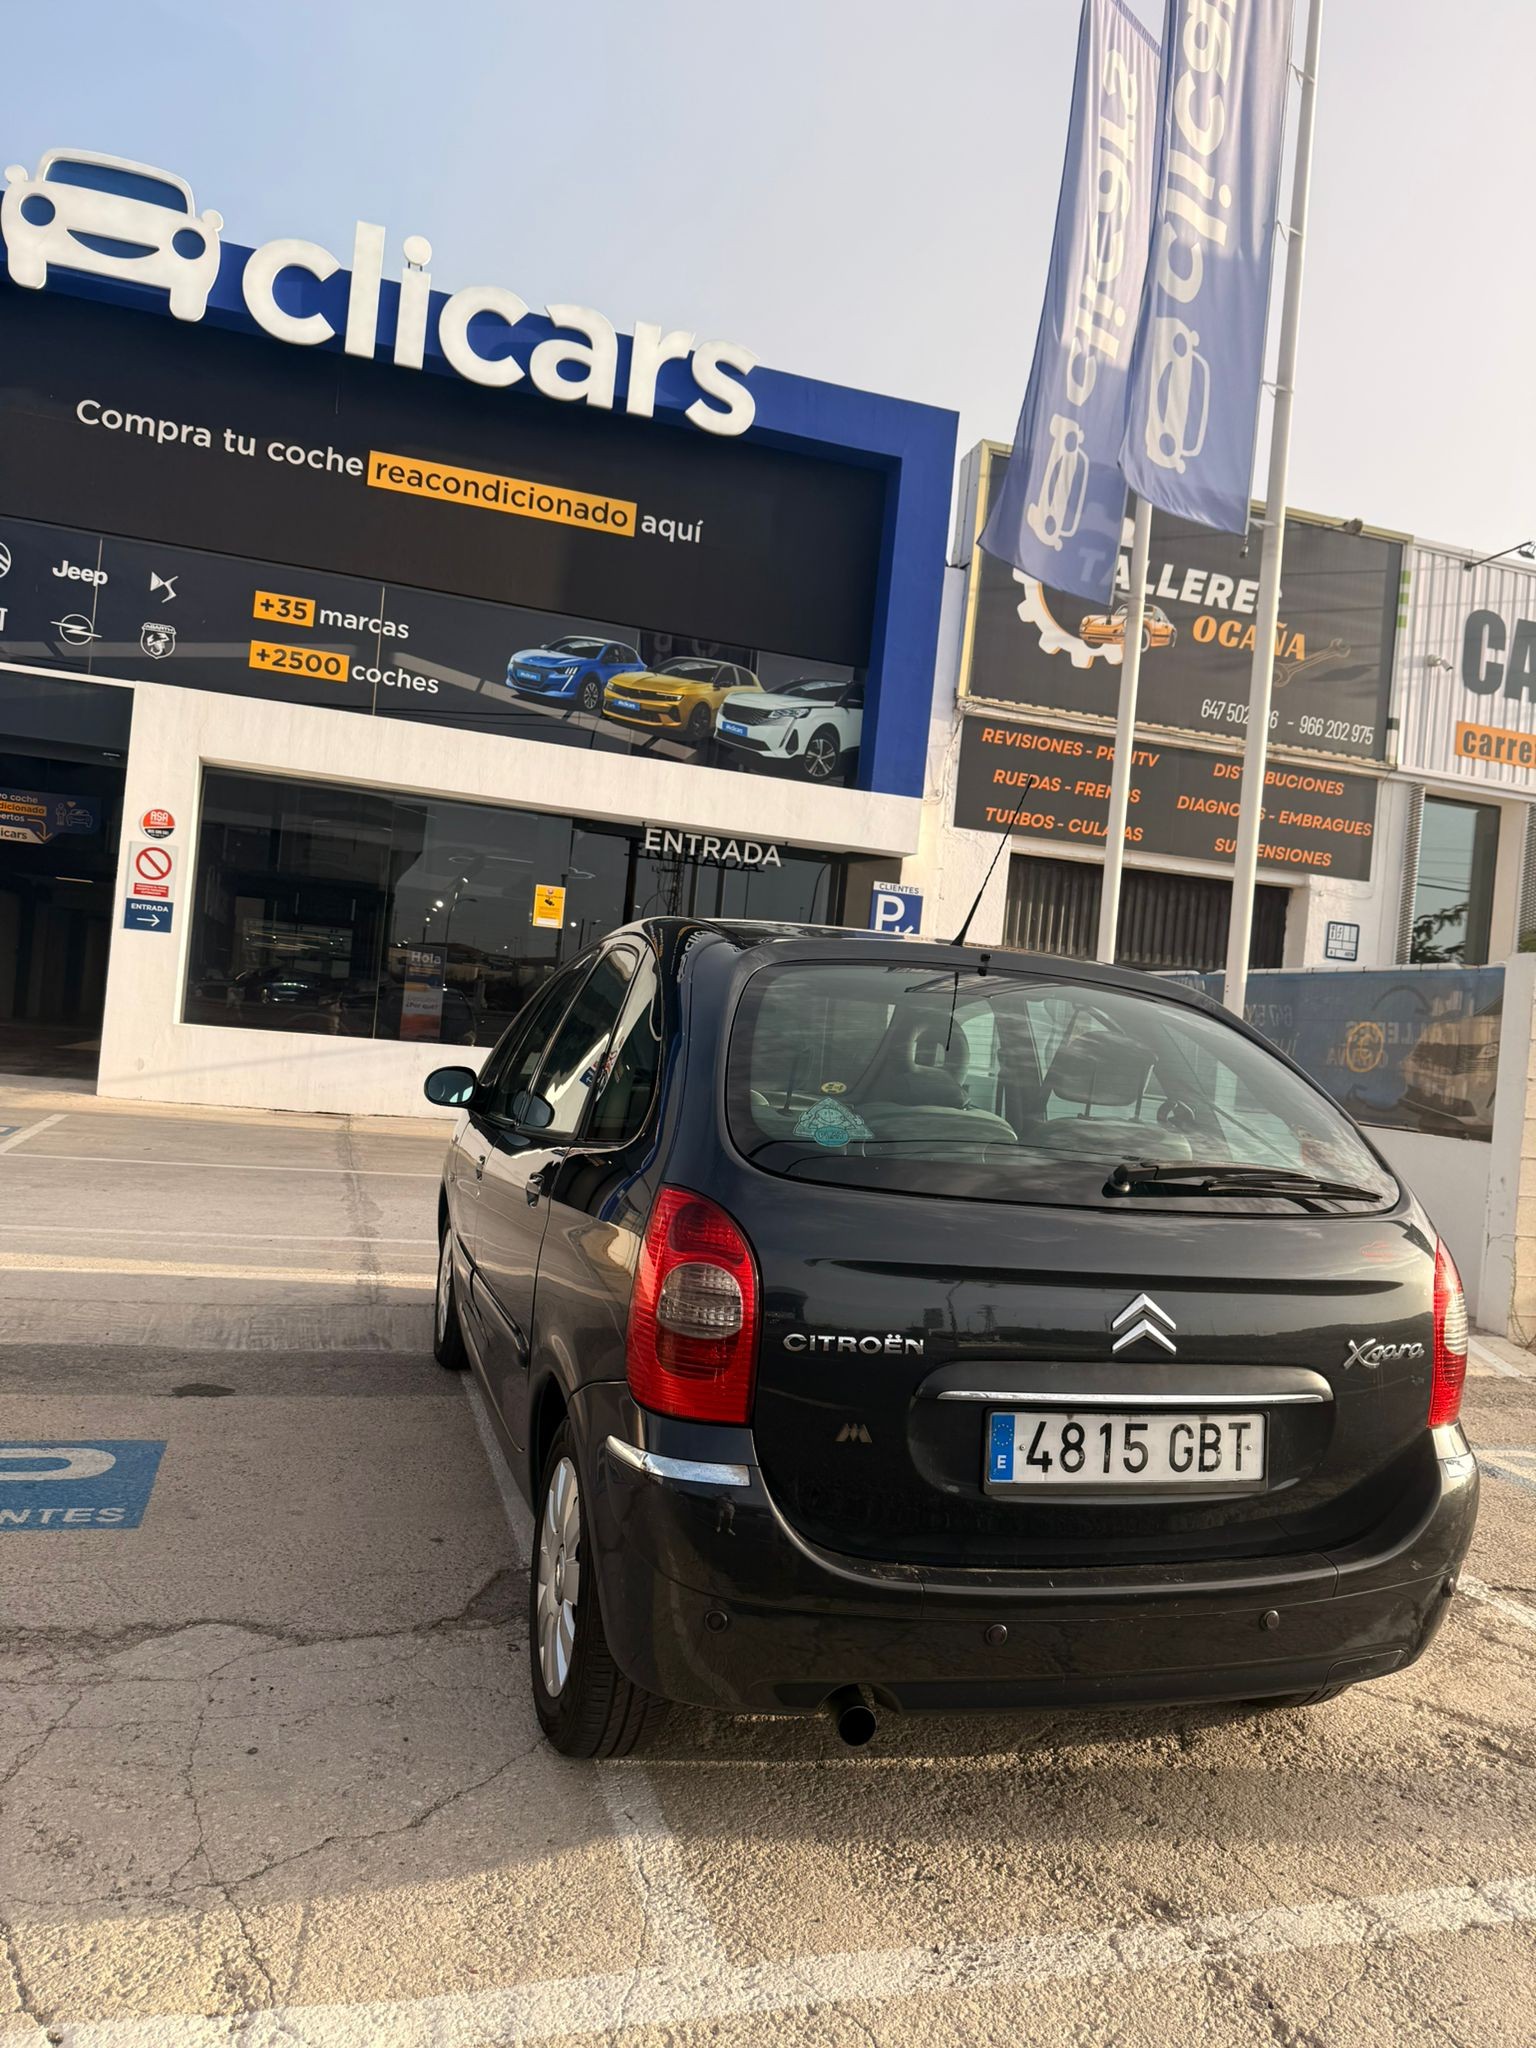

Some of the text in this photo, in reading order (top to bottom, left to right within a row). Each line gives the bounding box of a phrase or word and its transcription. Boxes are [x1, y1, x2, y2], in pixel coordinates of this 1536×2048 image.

[242, 220, 760, 437] clicars
[76, 399, 704, 543] Compra tu coche reacondicionado aquí
[52, 560, 109, 586] Jeep
[260, 598, 410, 639] +35 marcas
[256, 648, 440, 694] +2500 coches
[1200, 698, 1227, 721] 647
[981, 727, 1084, 757] REVISIONES
[1299, 715, 1325, 737] 966
[1325, 719, 1350, 741] 202
[1351, 724, 1375, 745] 975
[1463, 729, 1536, 765] carre
[992, 768, 1062, 792] RUEDAS
[0, 812, 25, 822] ertos
[985, 806, 1055, 830] TURBOS
[1279, 810, 1374, 837] EMBRAGUES
[644, 828, 783, 868] ENTRADA
[879, 882, 920, 895] CLIENTES
[130, 902, 169, 913] ENTRADA
[875, 893, 905, 931] P
[411, 951, 442, 965] Hola
[783, 1333, 925, 1355] CITROËN
[1343, 1337, 1425, 1370] Xsara
[997, 1454, 1007, 1469] E
[1026, 1421, 1252, 1474] 4815 GBT
